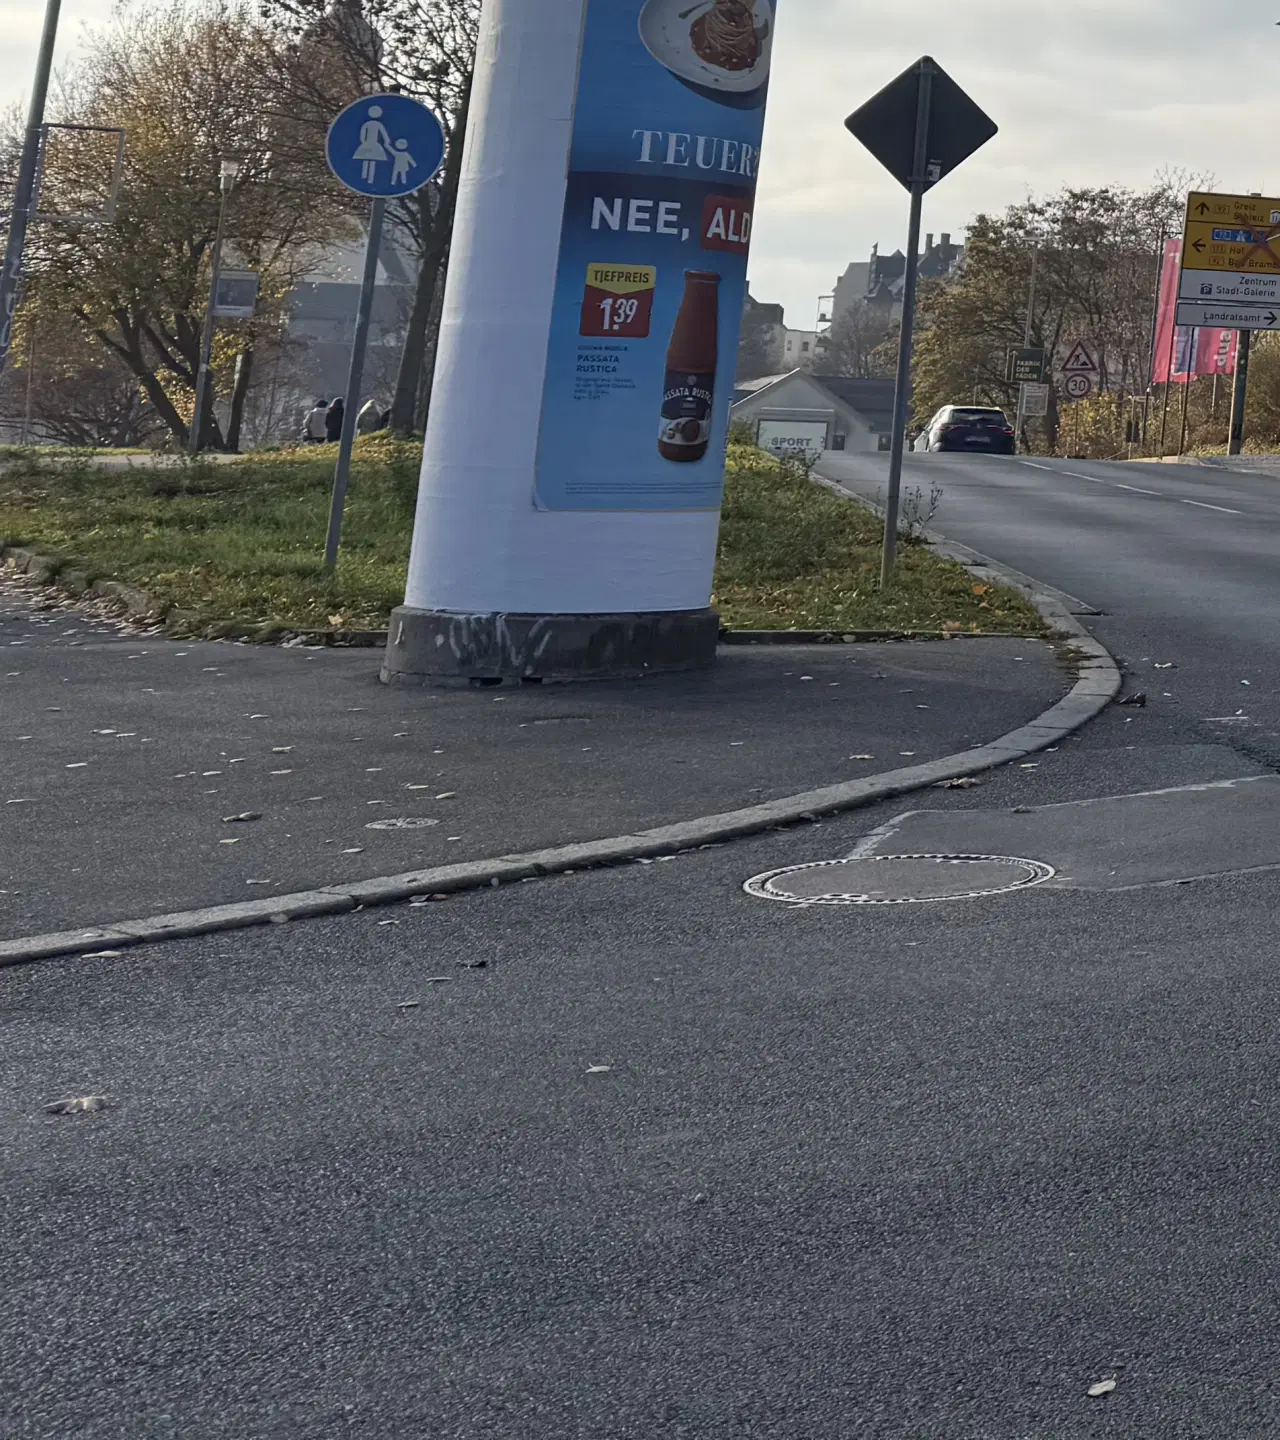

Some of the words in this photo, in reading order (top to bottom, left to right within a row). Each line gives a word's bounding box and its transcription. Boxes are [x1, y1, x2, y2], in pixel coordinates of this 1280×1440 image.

[1234, 202, 1257, 211] Greiz
[591, 197, 690, 241] NEE,
[706, 207, 750, 243] ALD
[1229, 246, 1244, 254] Hof
[594, 270, 650, 284] TIEFPREIS
[1239, 277, 1277, 286] Zentrum
[1216, 285, 1275, 297] Stadt-Galerie
[1203, 311, 1261, 322] Landratsamt
[577, 354, 620, 363] PASSATA
[576, 365, 617, 373] RUSTICA
[1070, 380, 1086, 392] 30
[771, 436, 812, 446] SPORT
